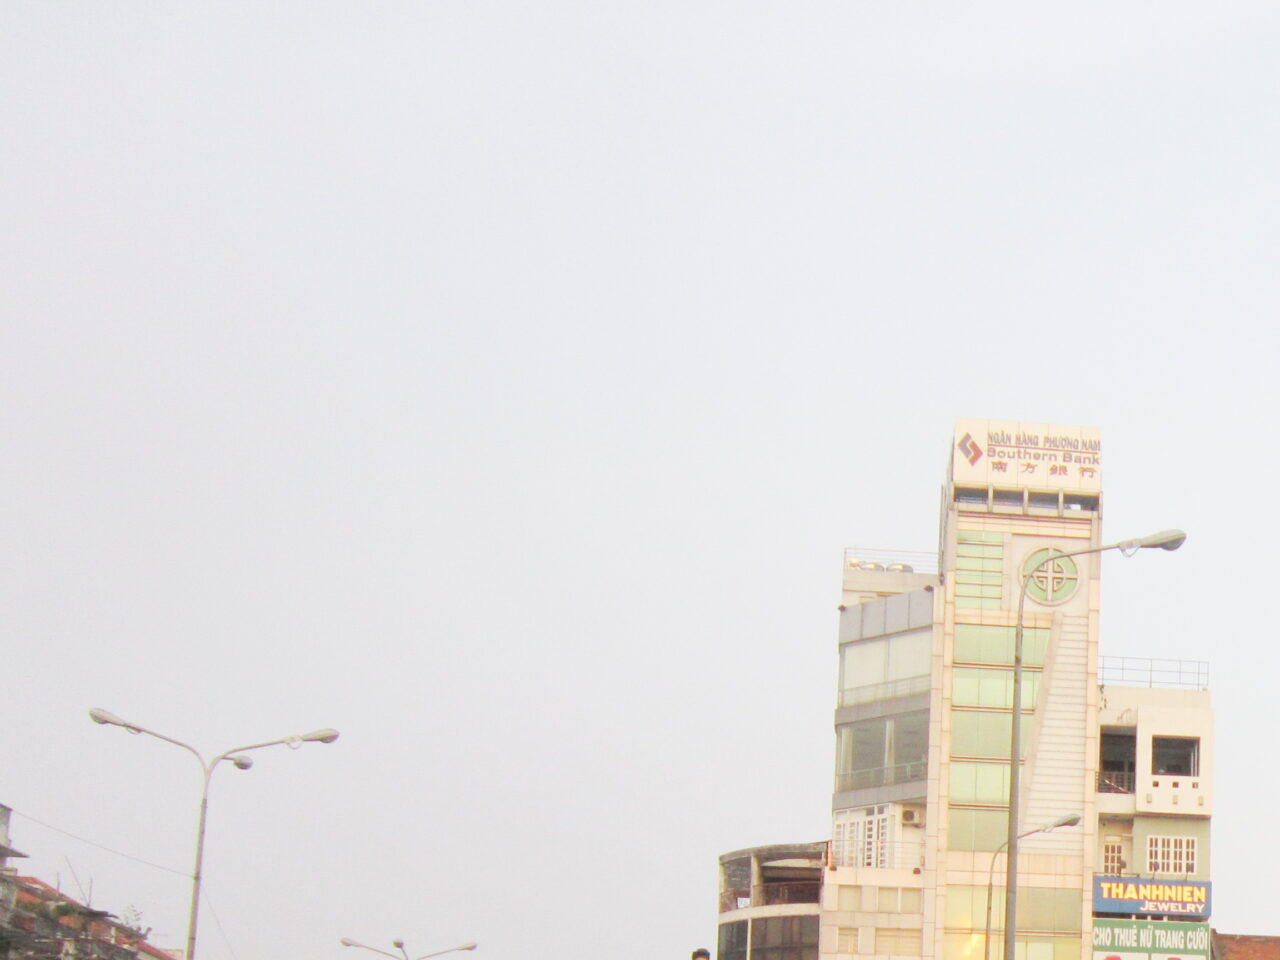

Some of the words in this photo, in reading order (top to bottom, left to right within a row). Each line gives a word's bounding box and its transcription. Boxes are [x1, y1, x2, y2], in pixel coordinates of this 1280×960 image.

[1015, 431, 1039, 447] HÀNG
[1081, 439, 1101, 452] NAM
[987, 447, 1058, 462] Southern
[1062, 452, 1100, 465] Bank
[1101, 882, 1206, 902] THANHNIEN
[1140, 901, 1205, 913] JEWELRY
[1093, 927, 1112, 946] CHO
[1114, 924, 1138, 947] THUÊ
[1155, 929, 1185, 949] TRANG
